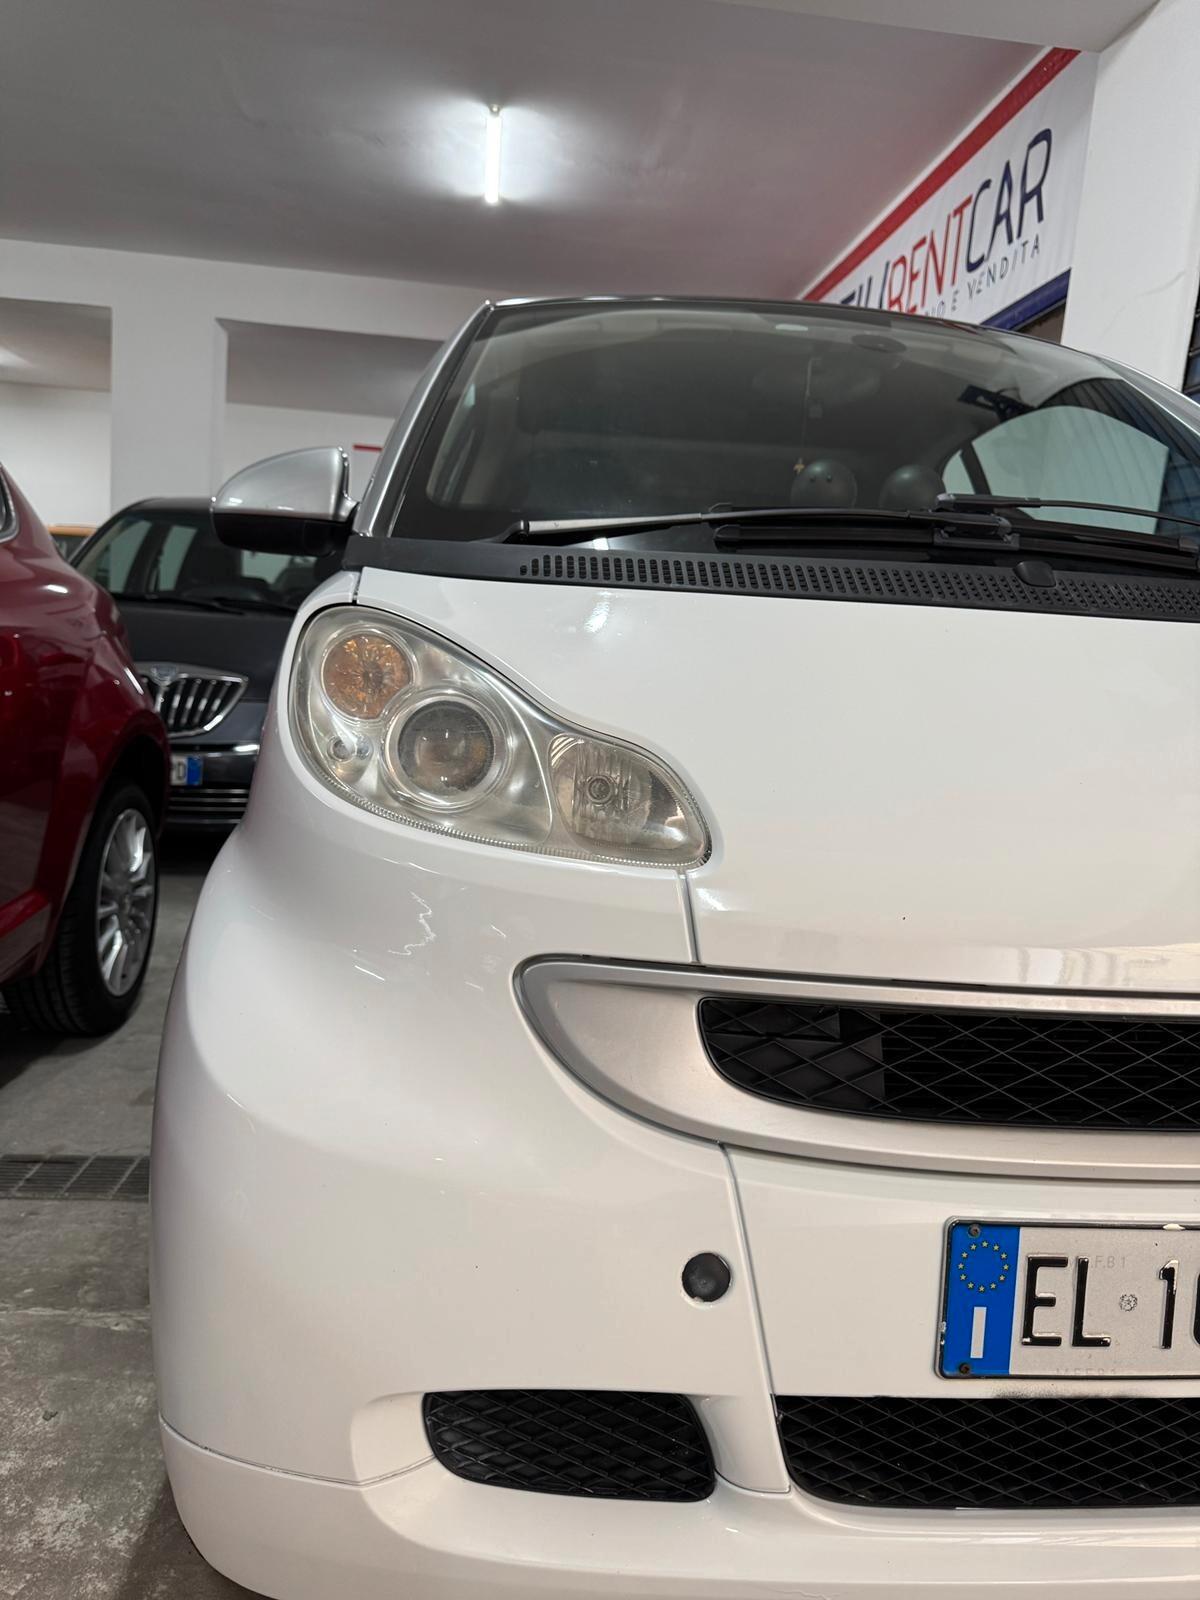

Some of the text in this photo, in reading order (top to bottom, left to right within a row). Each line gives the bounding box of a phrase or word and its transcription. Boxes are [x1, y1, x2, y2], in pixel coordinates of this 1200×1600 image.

[967, 233, 1040, 299] VENDITA
[1021, 1254, 1200, 1350] EL 1
